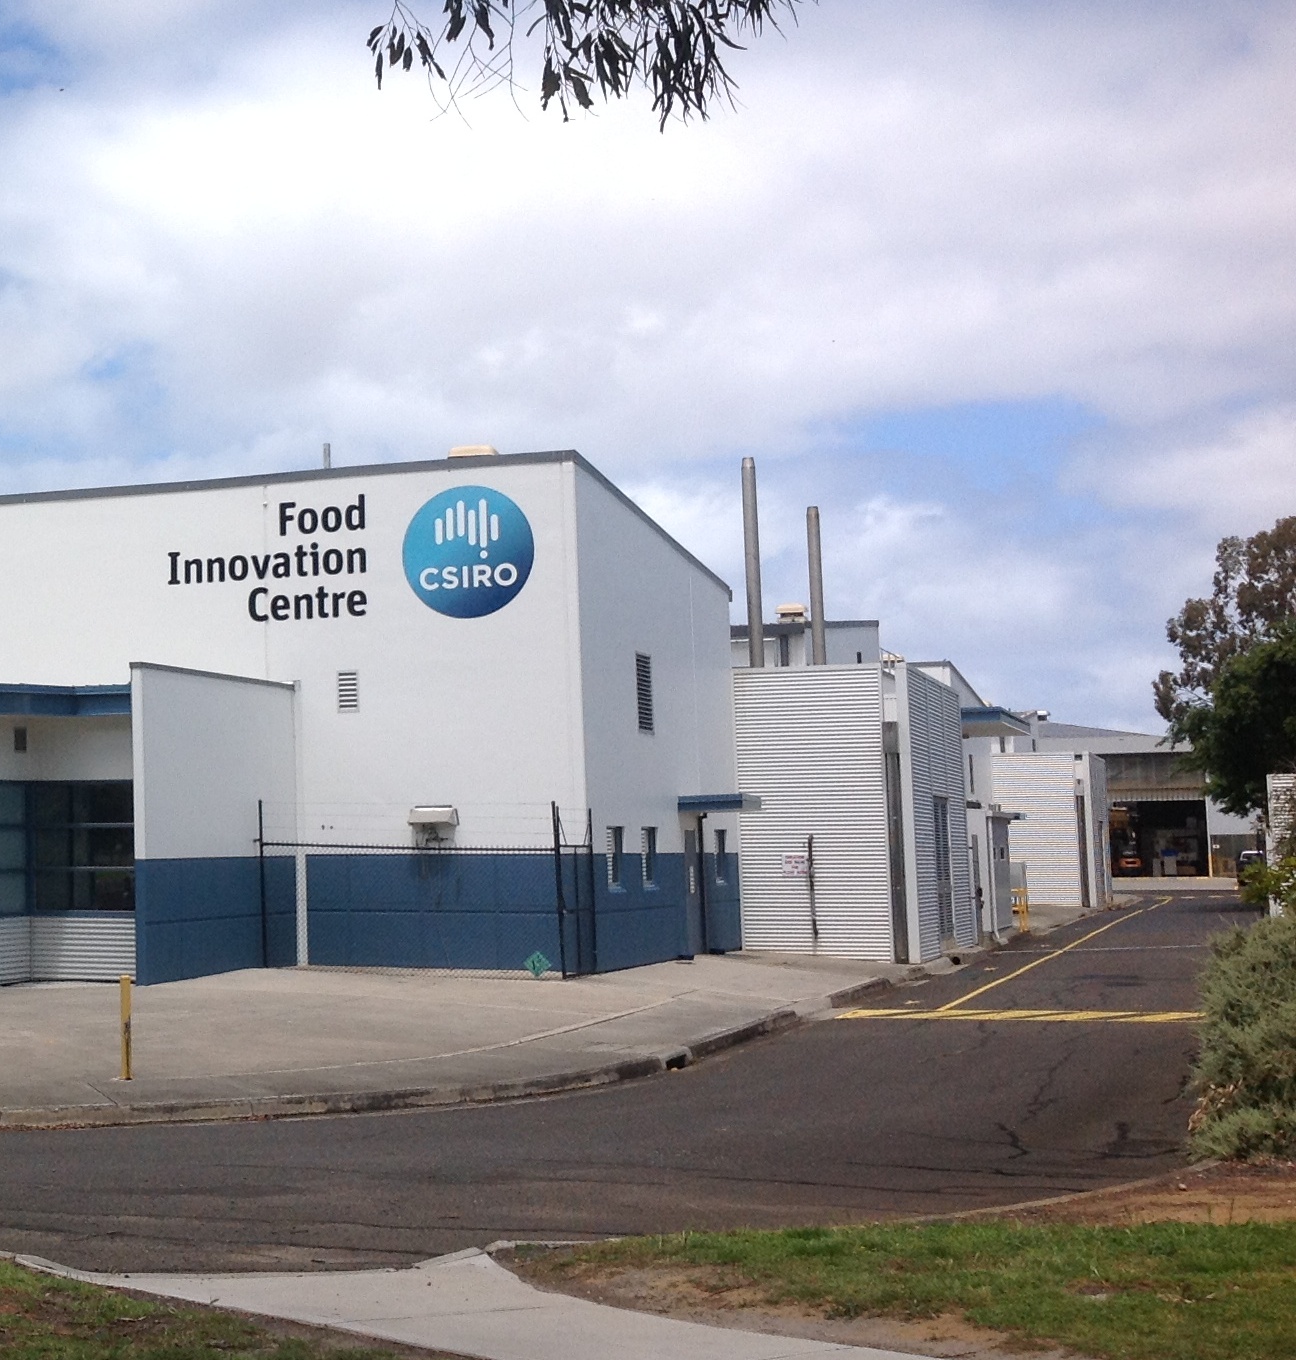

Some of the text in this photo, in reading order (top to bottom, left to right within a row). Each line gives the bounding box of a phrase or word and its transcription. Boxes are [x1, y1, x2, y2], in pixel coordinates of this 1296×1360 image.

[279, 494, 366, 536] Food
[167, 542, 367, 585] Innovation
[419, 562, 518, 591] CSIRO
[248, 586, 368, 622] Centre
